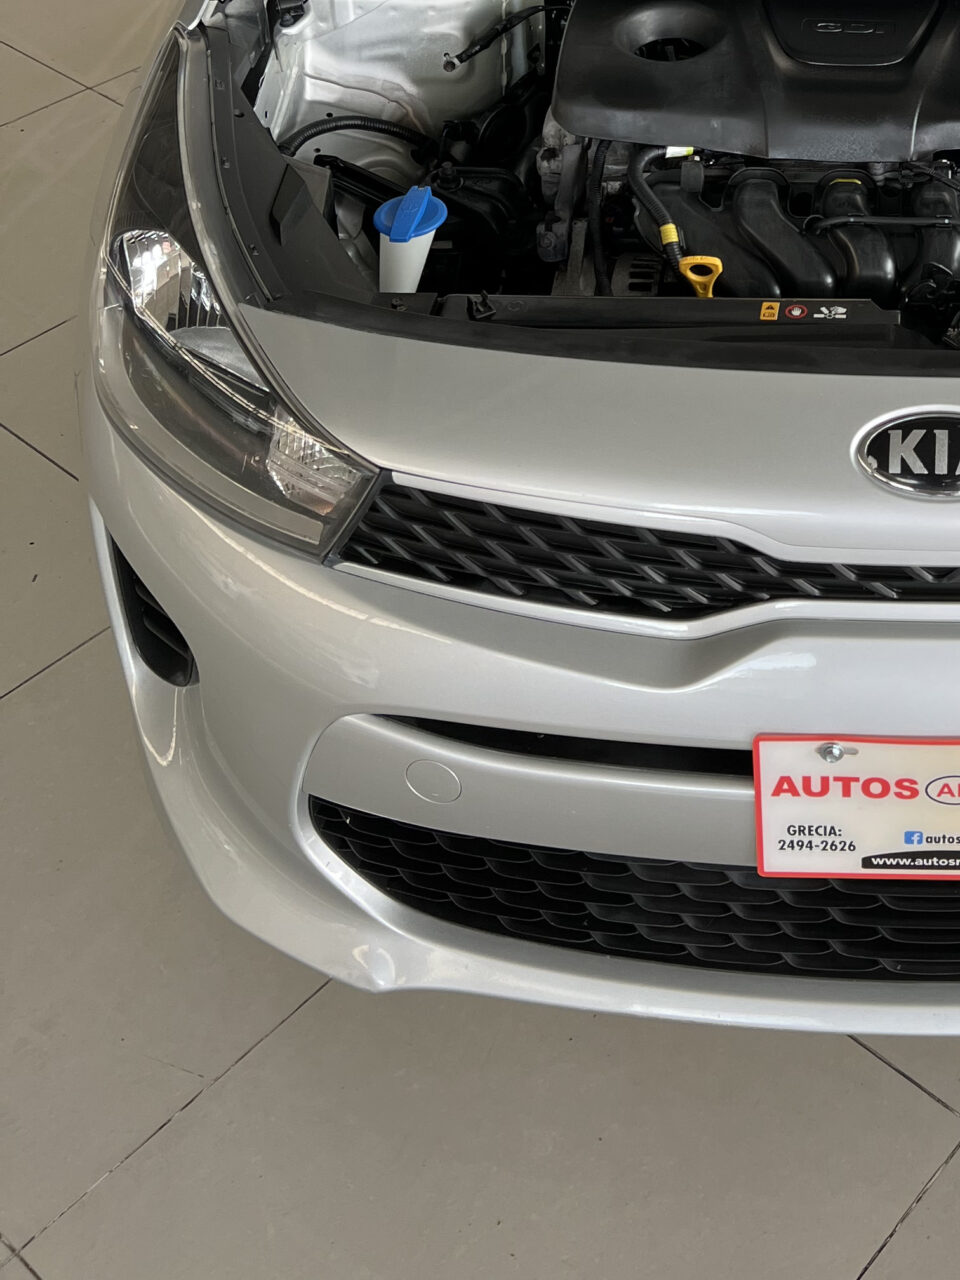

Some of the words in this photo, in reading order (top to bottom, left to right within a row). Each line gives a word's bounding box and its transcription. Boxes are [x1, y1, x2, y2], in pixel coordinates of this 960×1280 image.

[771, 775, 920, 800] AUTOS
[787, 825, 842, 837] GRECIA:
[778, 839, 856, 852] 2494-2626
